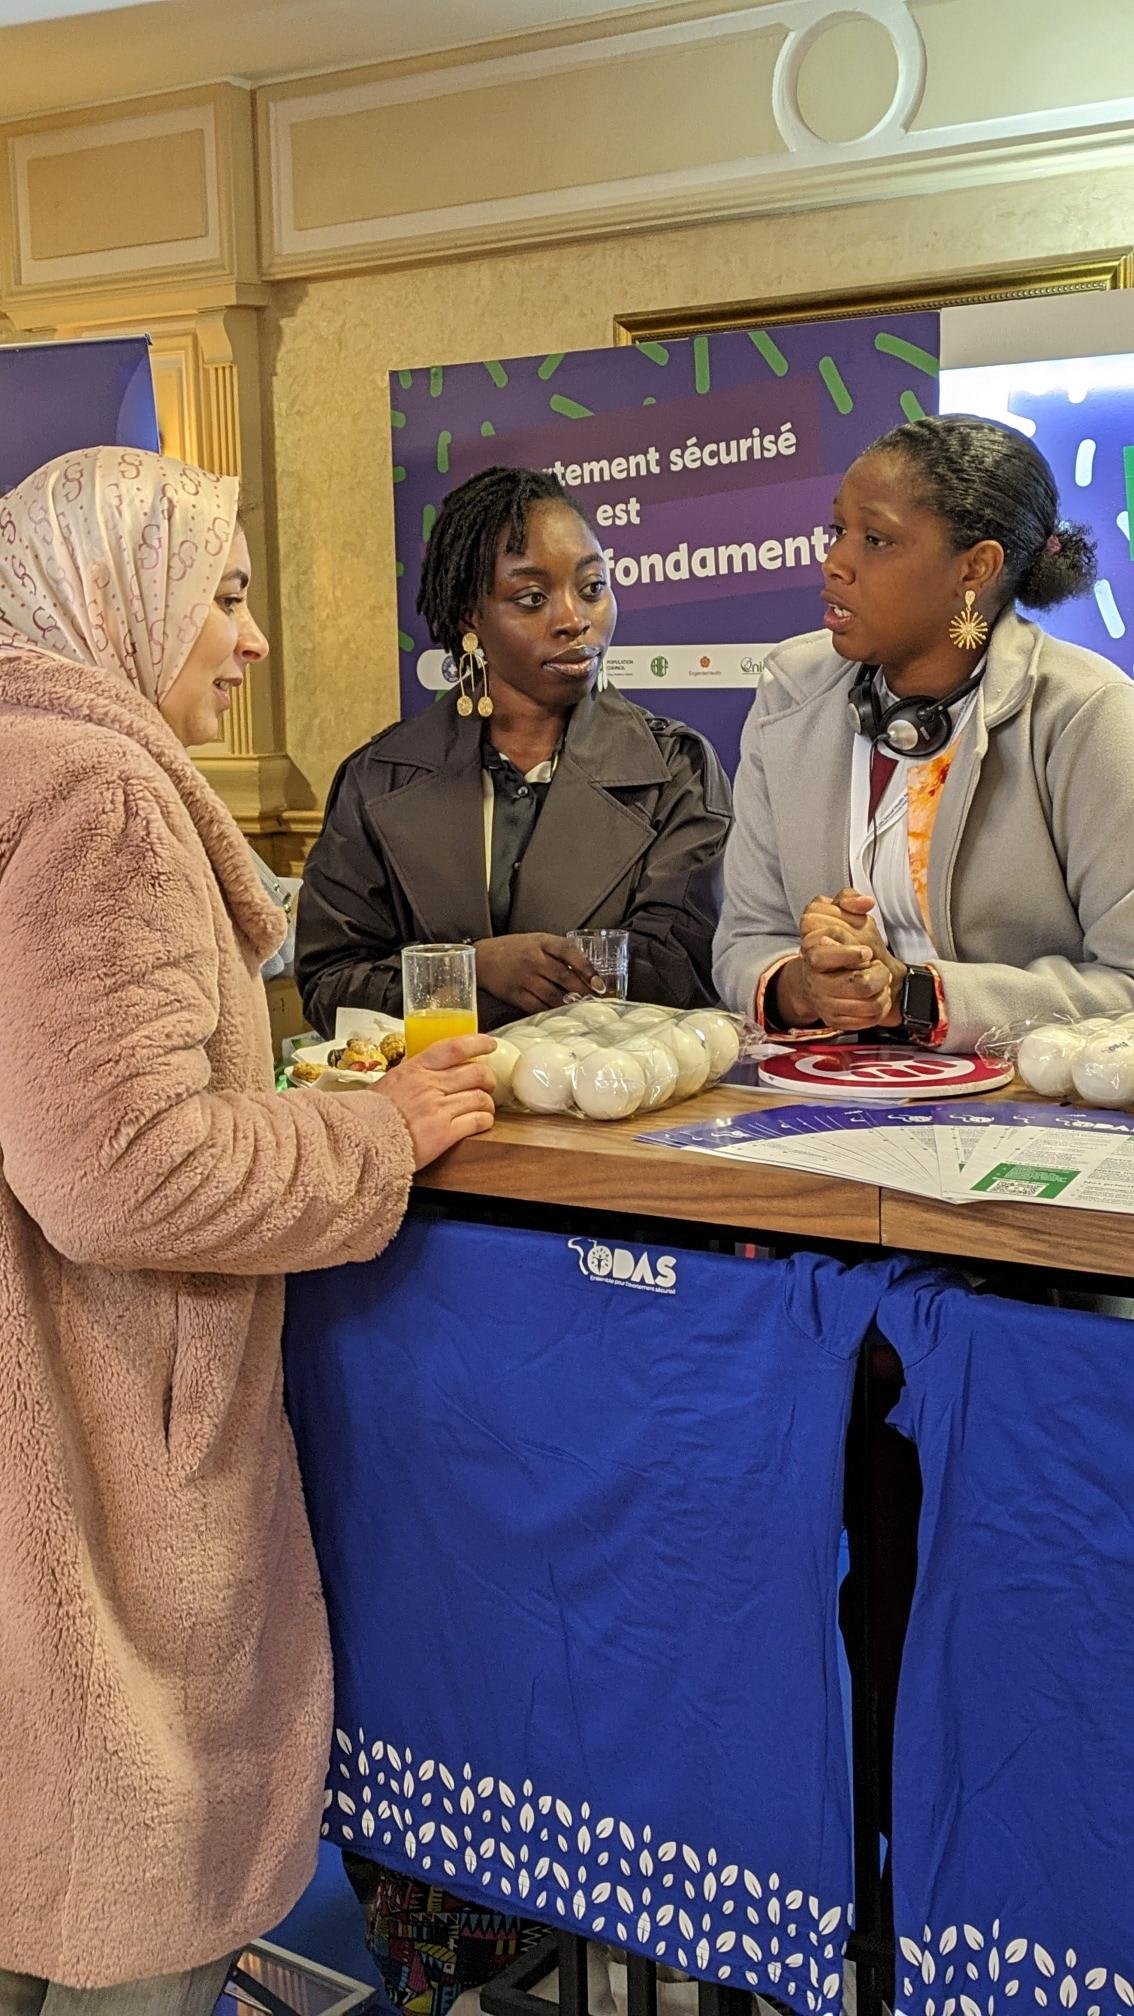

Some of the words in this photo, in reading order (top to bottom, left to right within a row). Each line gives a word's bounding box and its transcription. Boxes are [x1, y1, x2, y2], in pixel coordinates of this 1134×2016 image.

[542, 446, 661, 487] tement
[669, 421, 797, 472] sécurisé
[596, 497, 641, 527] est
[605, 526, 836, 587] fondament
[587, 1245, 677, 1288] ODAS
